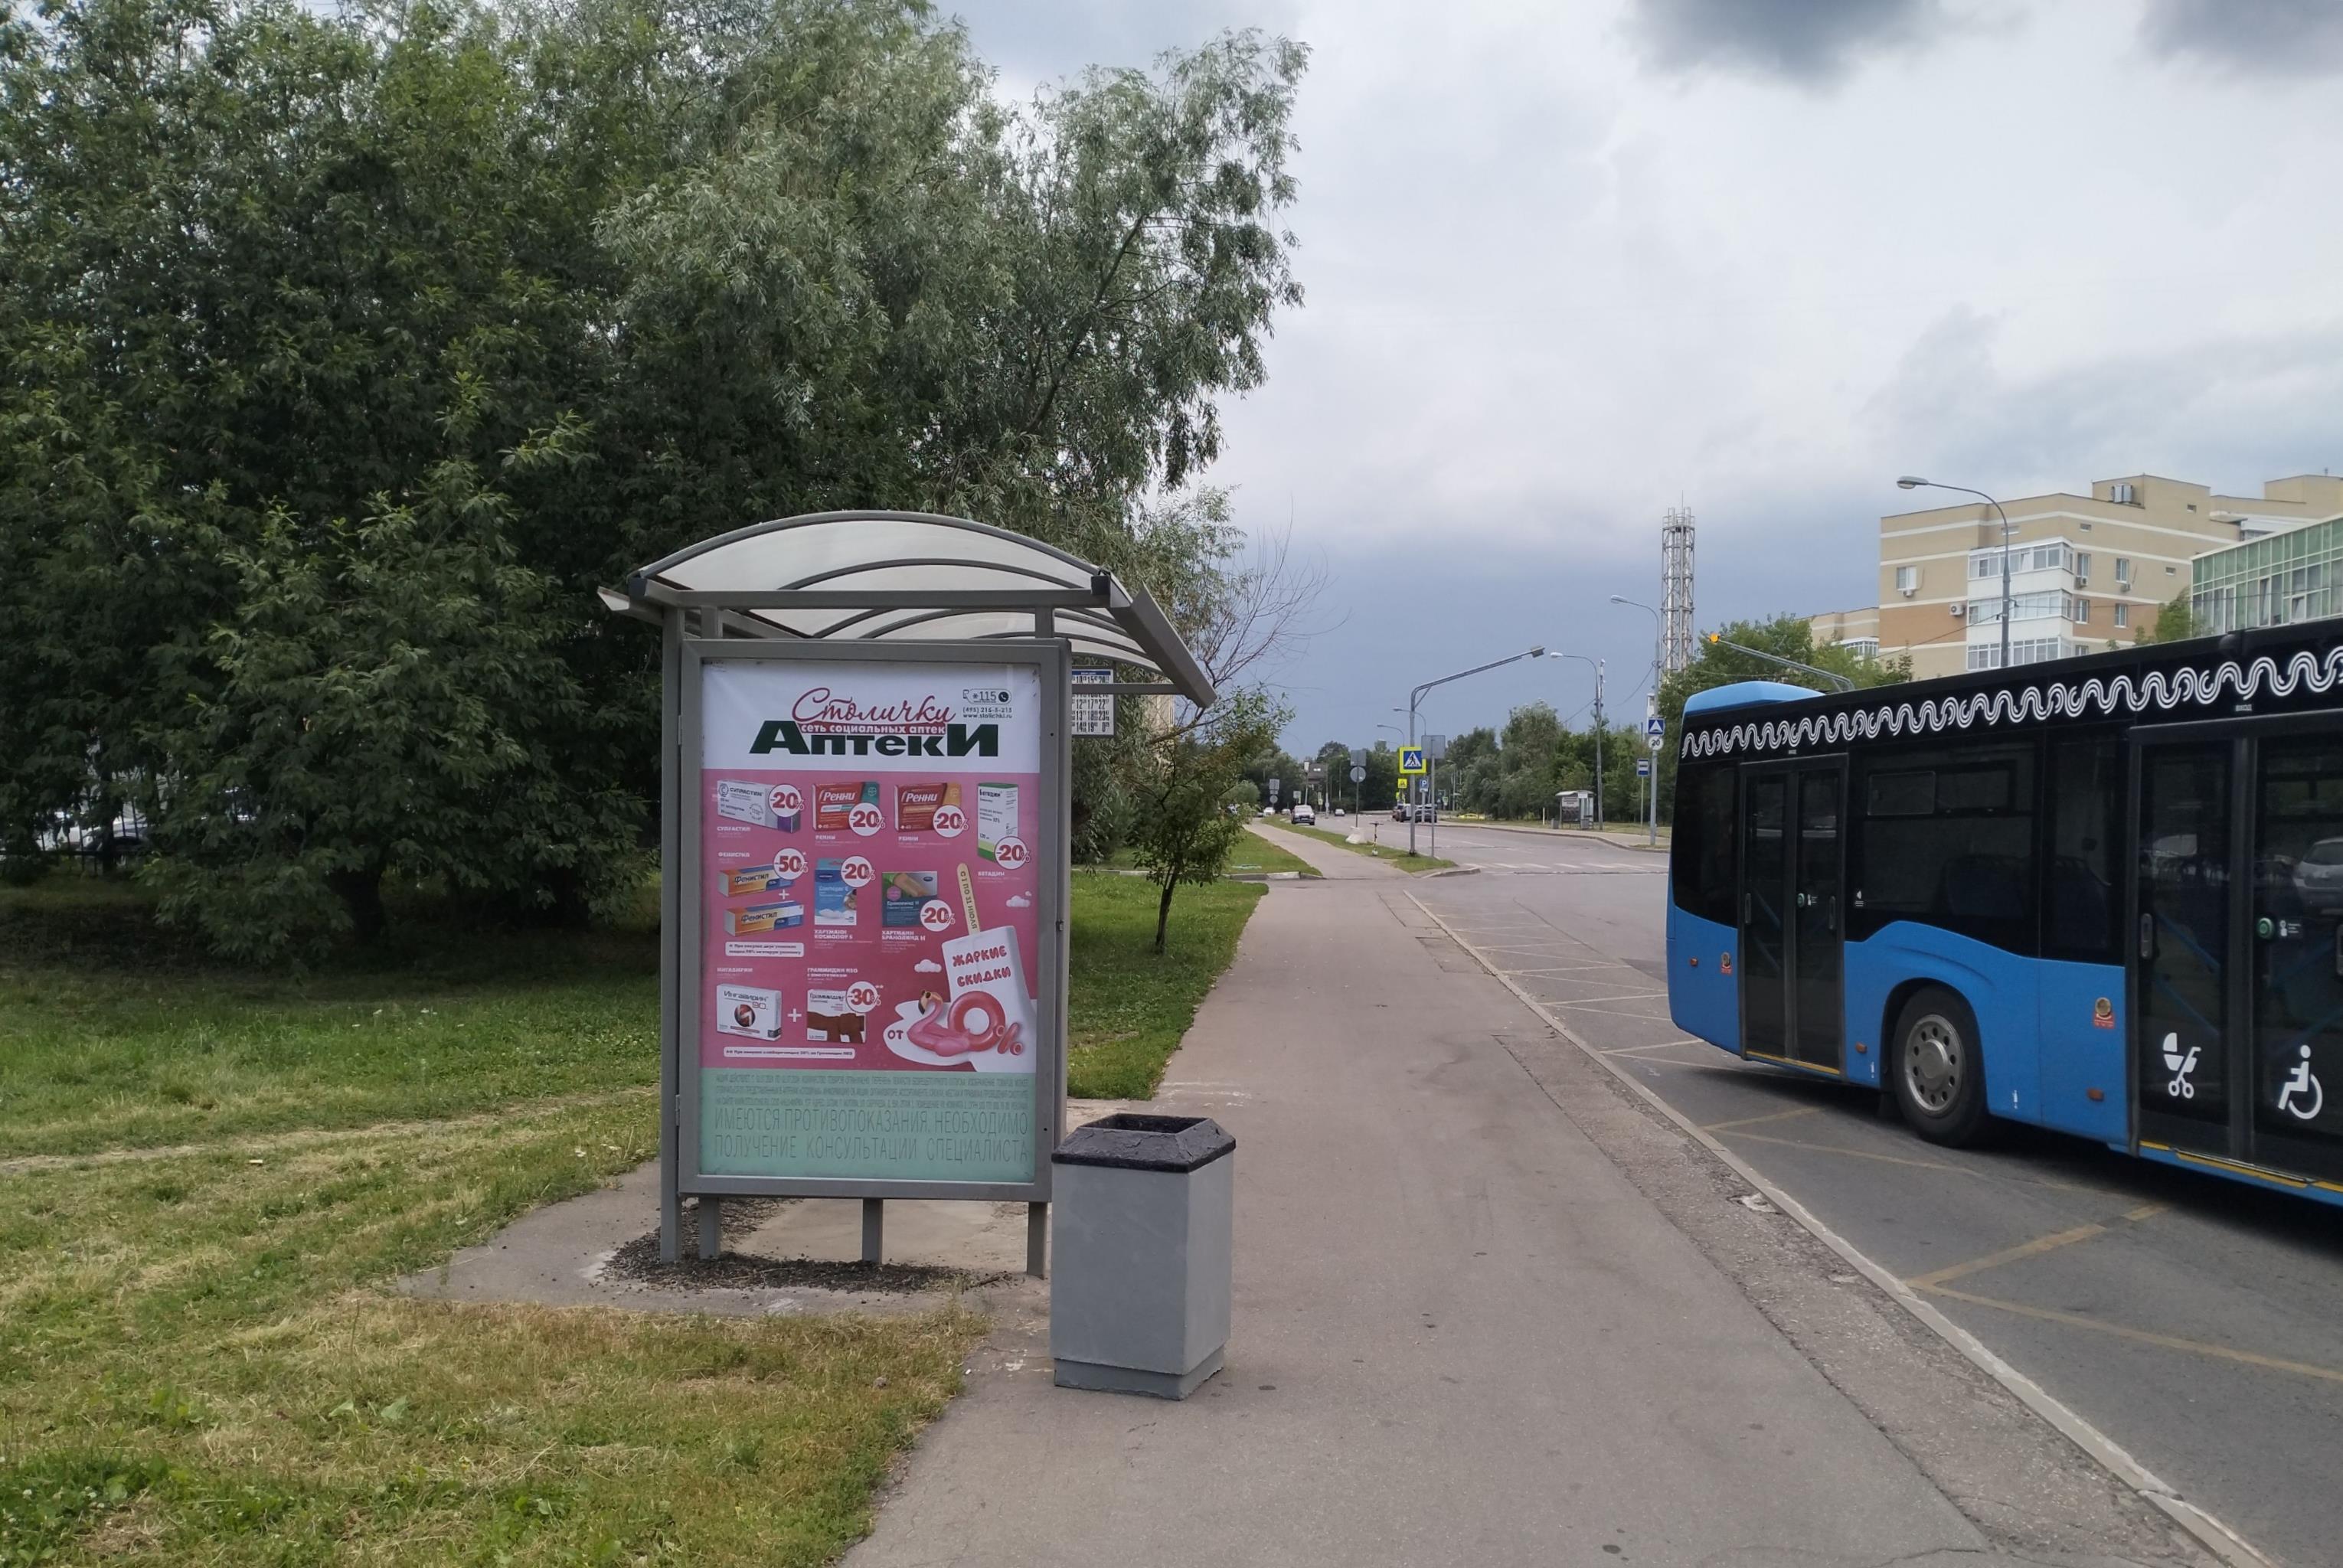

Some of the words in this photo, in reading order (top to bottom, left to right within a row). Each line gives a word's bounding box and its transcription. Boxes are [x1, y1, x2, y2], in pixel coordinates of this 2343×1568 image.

[792, 688, 956, 723] Столички
[801, 724, 827, 733] сеть
[829, 724, 907, 735] социальных
[909, 726, 946, 734] аптек
[822, 791, 856, 802] Ренни
[905, 792, 938, 802] Ренни
[953, 946, 1008, 967] ЖАРКИЕ
[957, 966, 1011, 987] СКИДКИ
[887, 1030, 904, 1040] ОТ
[715, 1108, 779, 1131] ИМЕЮТСЯ
[935, 1111, 1028, 1137] НЕОБХОДИМО
[715, 1134, 797, 1158] ПОЛУЧЕНИЕ
[806, 1136, 917, 1162] КОНСУЛЬТАЦИИ
[926, 1138, 1030, 1164] СПЕЦИАЛИСТА
